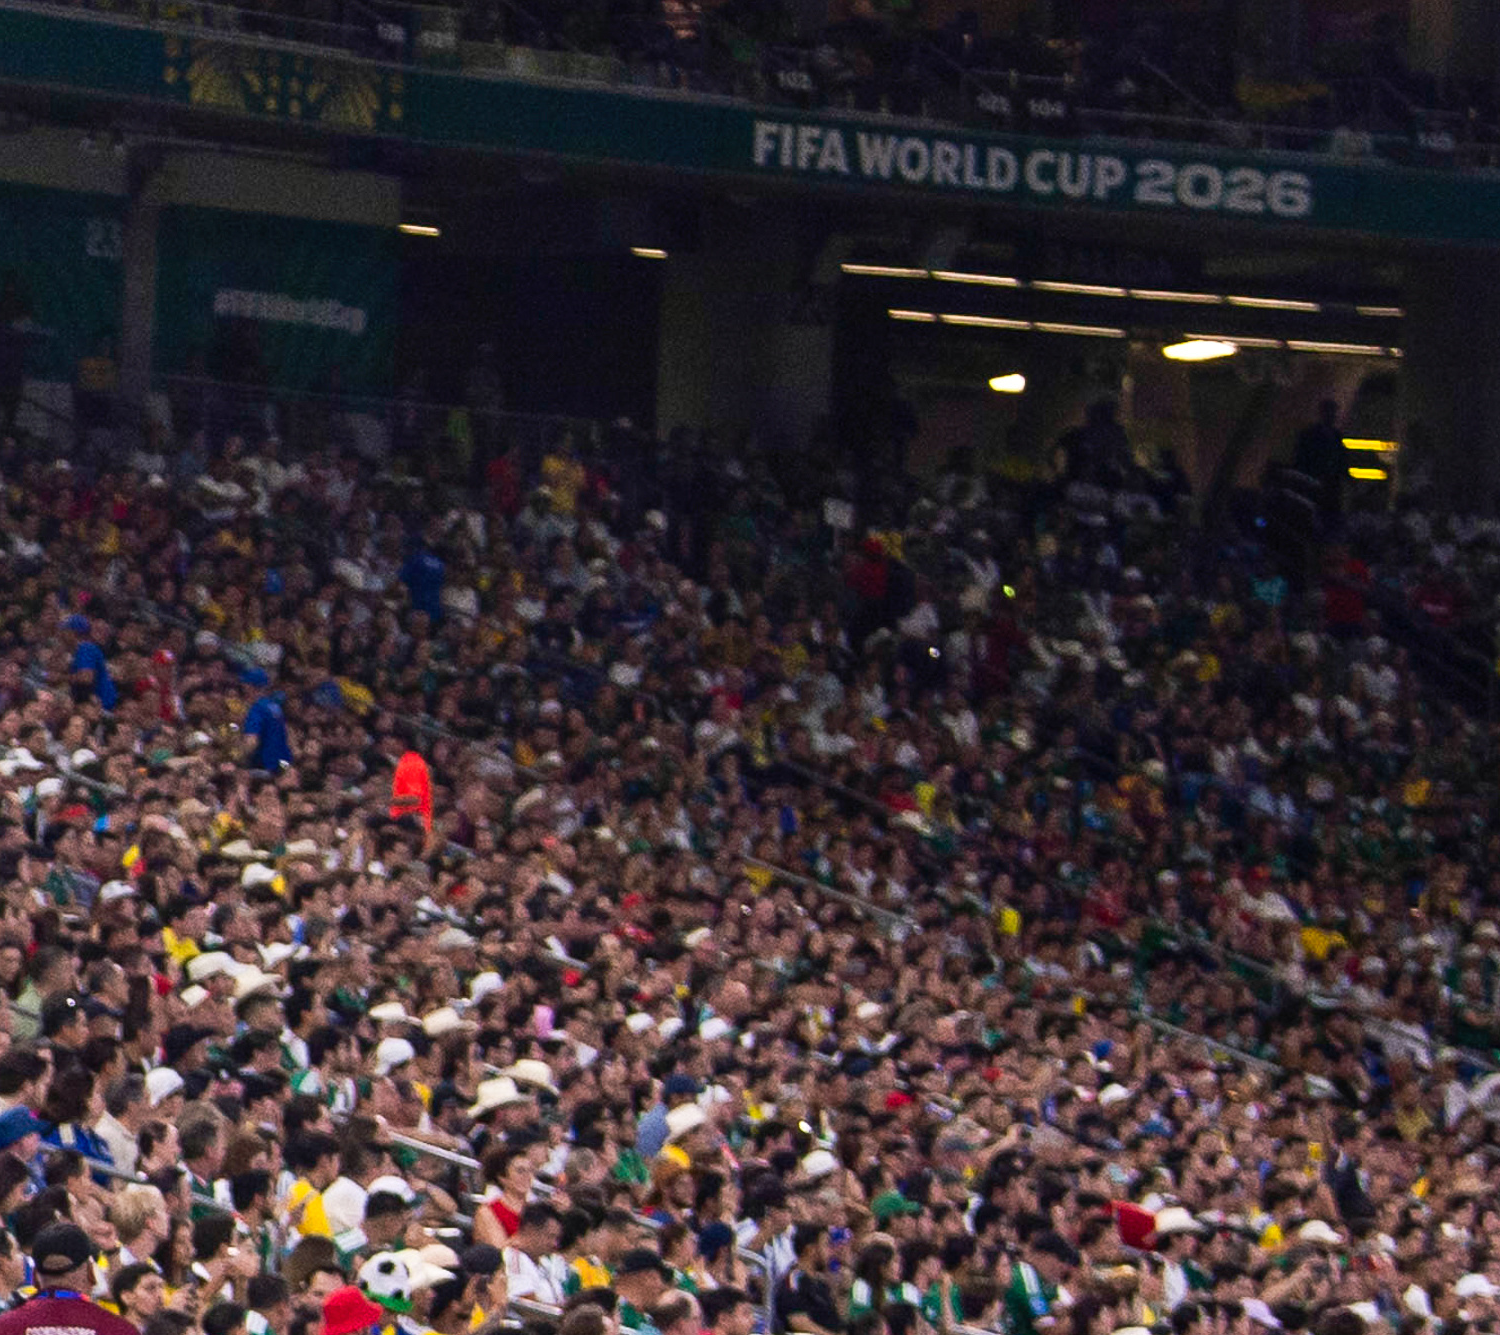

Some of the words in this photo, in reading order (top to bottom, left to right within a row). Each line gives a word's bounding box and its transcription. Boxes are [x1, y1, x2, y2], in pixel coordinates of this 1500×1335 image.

[751, 119, 850, 177] FIFA
[855, 130, 1019, 194] WORLD
[1023, 147, 1128, 201] CUP
[1132, 159, 1315, 219] 2026
